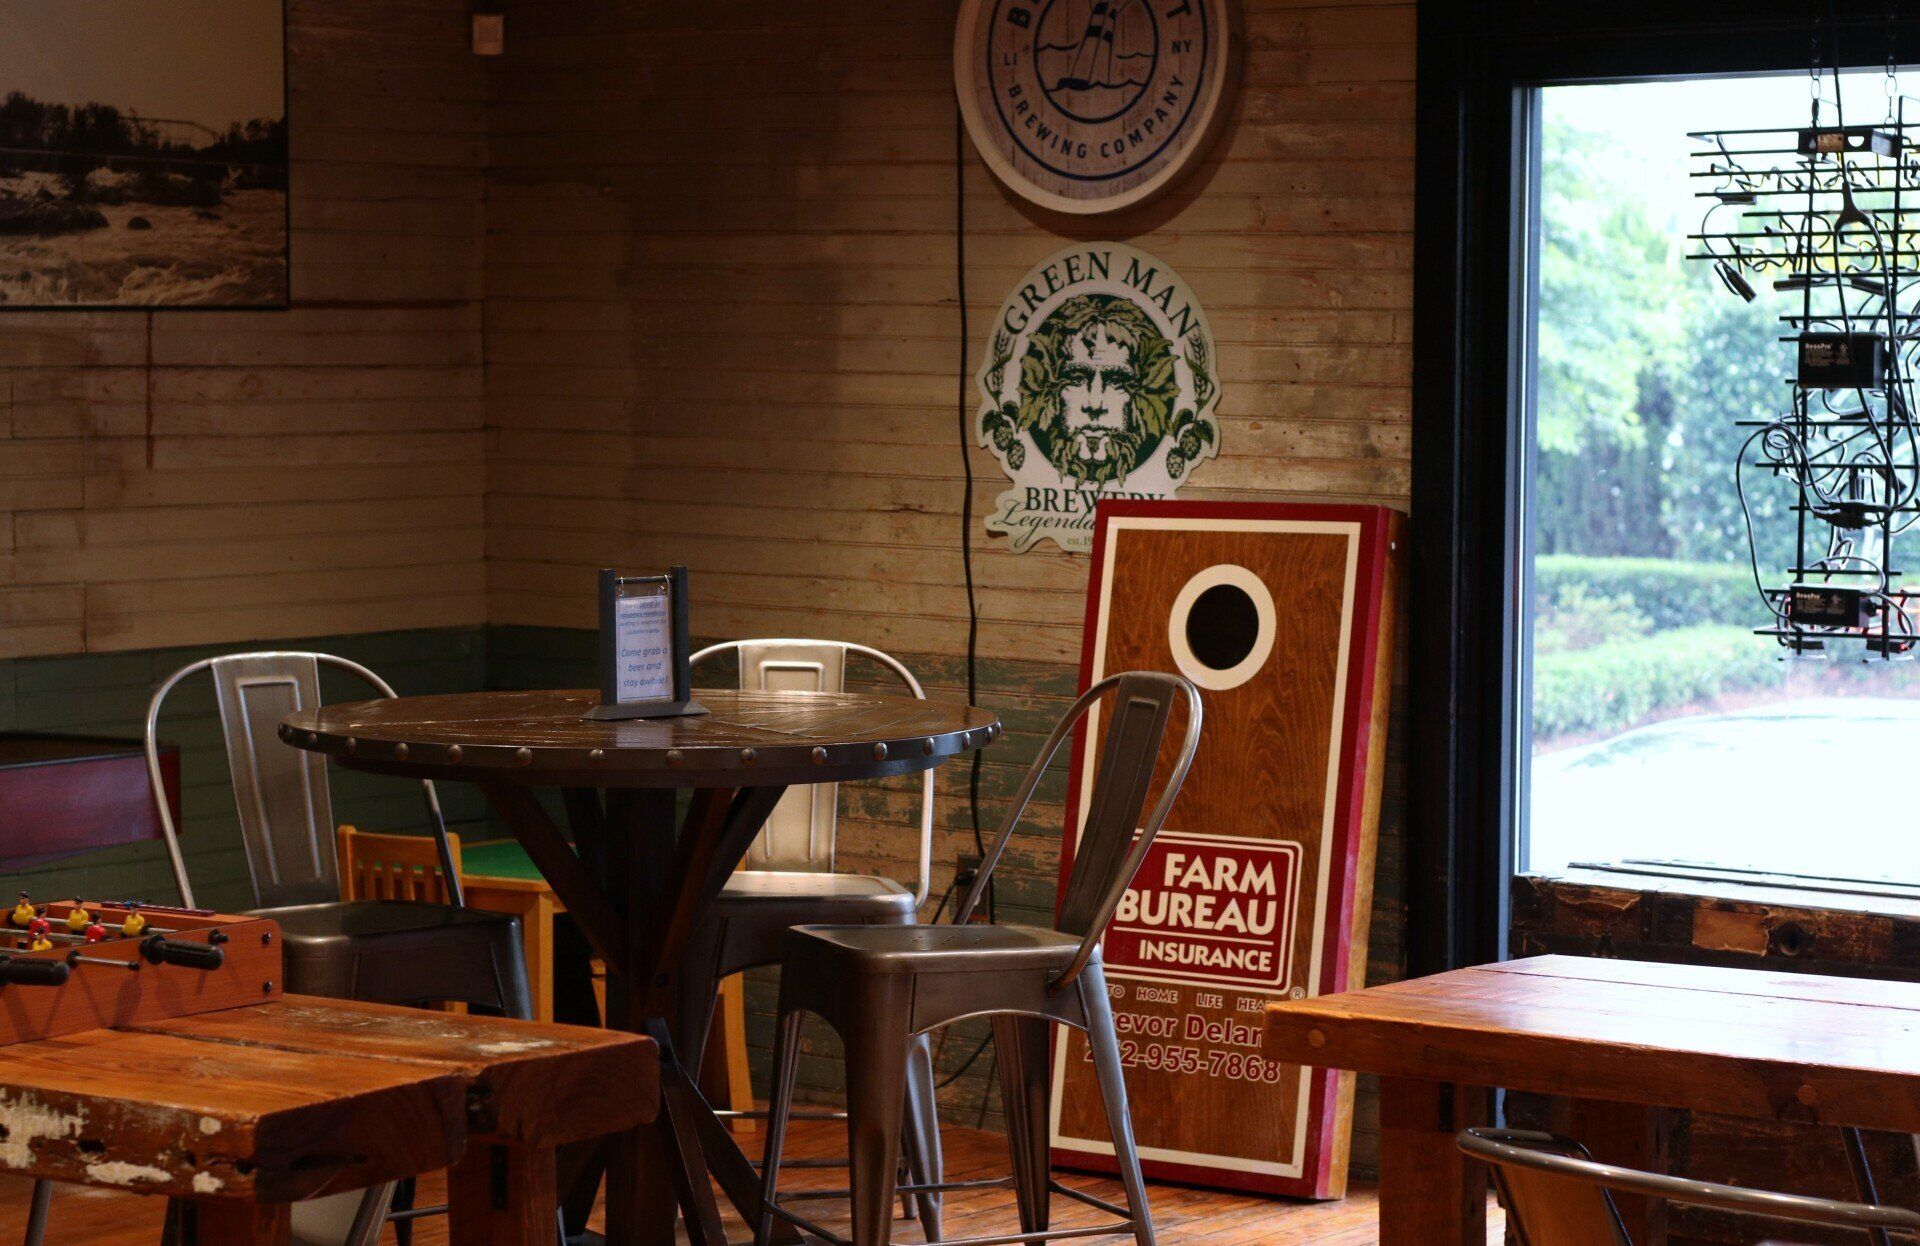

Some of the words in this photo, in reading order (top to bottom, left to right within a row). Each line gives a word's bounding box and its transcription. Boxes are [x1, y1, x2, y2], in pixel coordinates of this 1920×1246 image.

[1003, 53, 1018, 66] LI
[1171, 39, 1192, 54] NY
[1008, 84, 1088, 159] BREWING
[1100, 74, 1185, 158] COMPANY
[1003, 251, 1112, 335] GREEN
[1122, 256, 1201, 338] MAN
[1025, 486, 1166, 515] BREW
[993, 499, 1096, 549] Legenda
[621, 648, 641, 658] Come
[643, 645, 661, 658] grab
[662, 647, 668, 655] a
[628, 663, 645, 671] beer
[646, 661, 662, 670] and
[623, 679, 639, 688] stay
[639, 674, 668, 686] awhile!
[1163, 852, 1277, 896] FARM
[1115, 888, 1277, 936] BUREAU
[1138, 939, 1273, 973] INSURANCE
[1106, 983, 1125, 999] TO
[1136, 986, 1179, 1004] HOME
[1196, 992, 1224, 1009] LIFE
[1236, 997, 1271, 1014] HEA
[1111, 1011, 1178, 1038] evor
[1184, 1013, 1264, 1048] Delan
[1084, 1038, 1281, 1084] 2-955-7868
